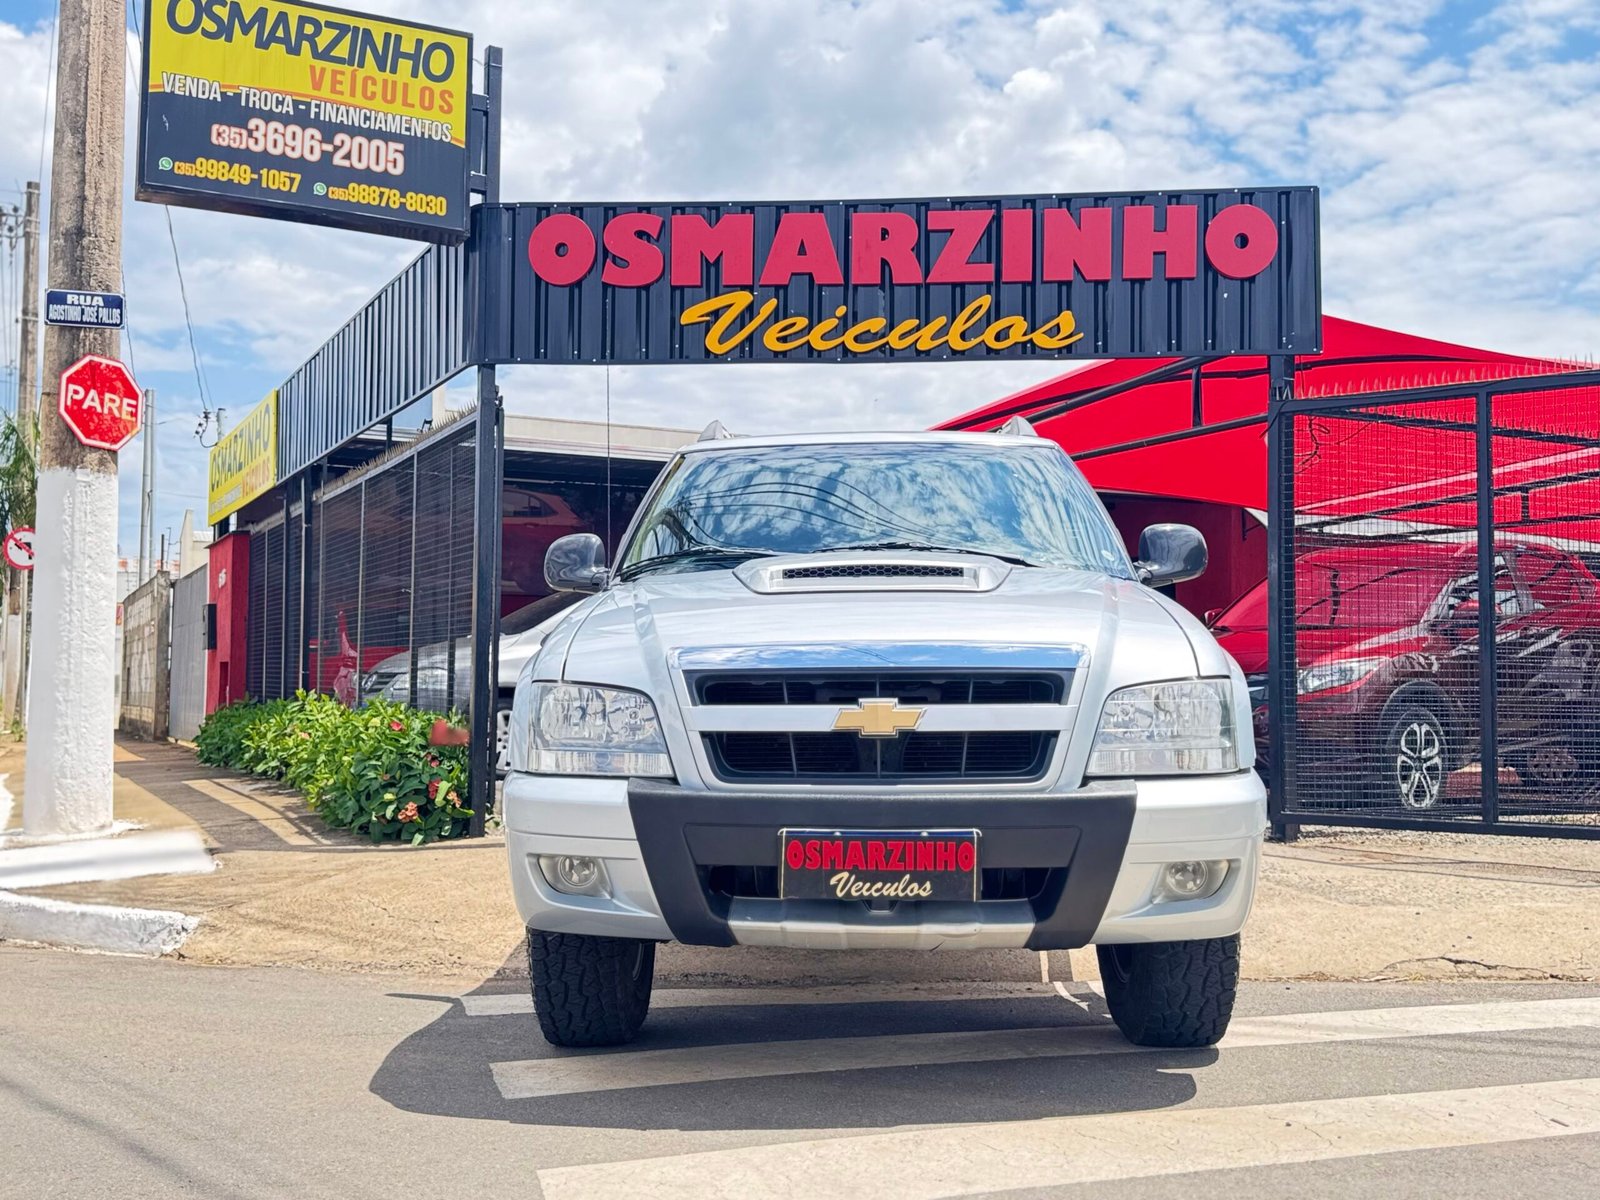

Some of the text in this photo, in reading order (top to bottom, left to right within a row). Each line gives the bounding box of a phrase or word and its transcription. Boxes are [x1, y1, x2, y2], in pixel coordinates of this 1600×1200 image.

[166, 0, 456, 83] OSMARZINHO
[162, 72, 222, 102] VENDA
[239, 86, 294, 116] TROCA
[310, 100, 452, 143] FINANCIAMENTOS
[309, 64, 455, 114] VEÍCULOS
[210, 117, 405, 176] (35)3696-2005
[528, 203, 1280, 288] OSMARZINHO
[48, 304, 82, 321] AGOSTINHO
[98, 307, 121, 324] PALLOS
[66, 294, 104, 307] RUA
[680, 290, 1084, 356] Veiculos
[66, 383, 137, 422] PARE
[210, 403, 271, 493] OSMARZINHO
[786, 839, 976, 872] OSMARZINHO
